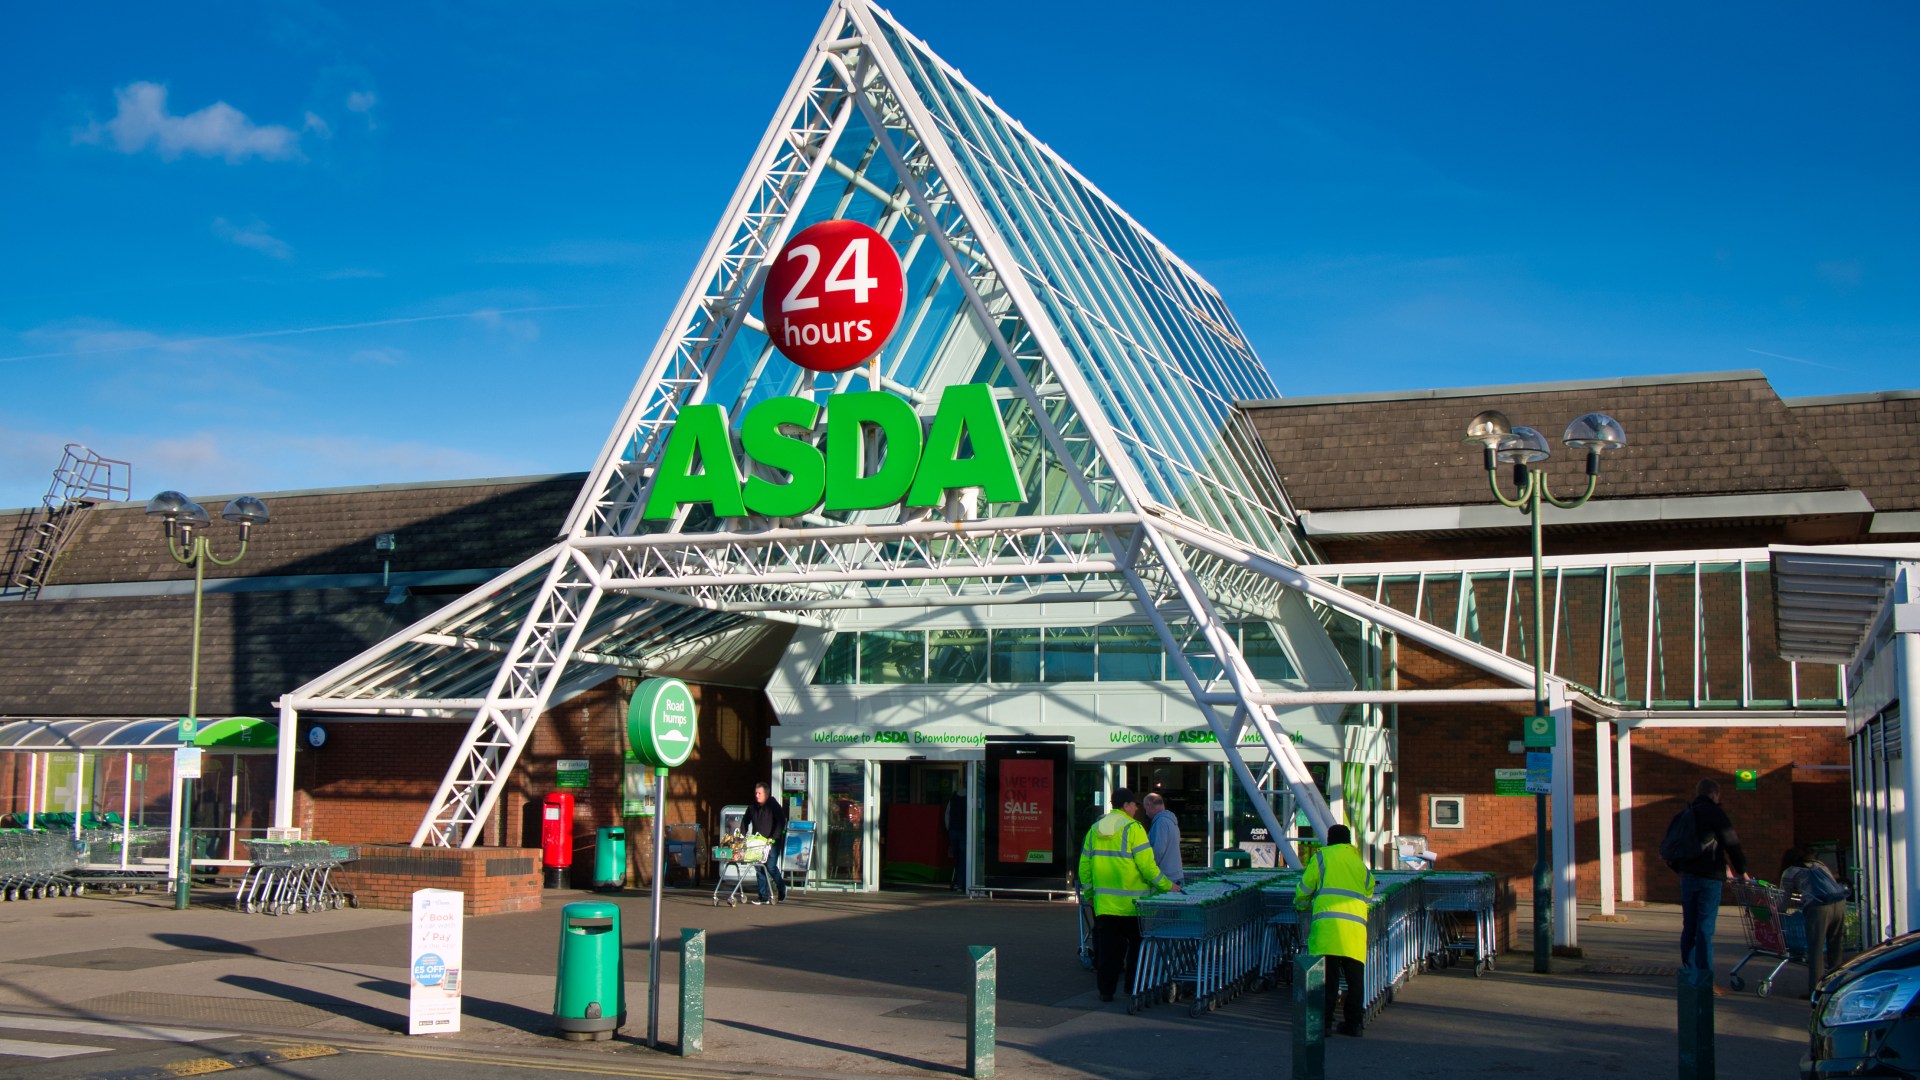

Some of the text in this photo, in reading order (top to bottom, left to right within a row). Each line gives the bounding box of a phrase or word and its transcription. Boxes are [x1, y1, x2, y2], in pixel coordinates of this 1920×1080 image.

[781, 237, 878, 313] 24
[783, 316, 873, 348] hours
[643, 382, 1028, 521] ASDA
[666, 699, 685, 712] Road
[663, 711, 687, 728] humps
[814, 730, 987, 747] Welcome to ASDA Bromborough
[1109, 730, 1218, 744] Welcome to ASDA
[568, 761, 588, 769] parking
[1004, 776, 1049, 789] WE'RE
[1004, 789, 1027, 801] ON
[1004, 801, 1043, 815] SALE.
[429, 912, 454, 922] Book
[432, 932, 452, 942] Pay
[426, 965, 445, 973] OFF
